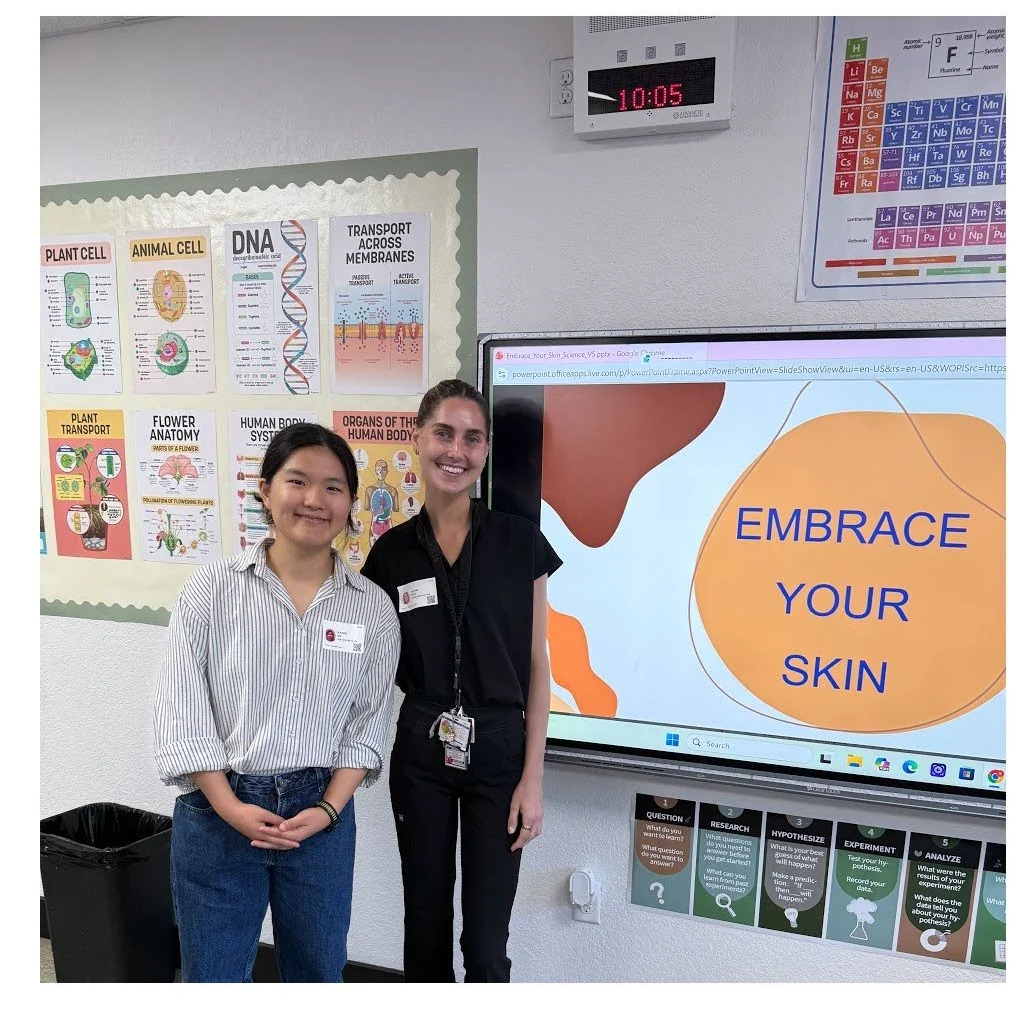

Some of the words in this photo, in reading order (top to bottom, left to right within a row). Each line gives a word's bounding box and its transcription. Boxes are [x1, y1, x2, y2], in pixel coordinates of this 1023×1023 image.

[934, 38, 941, 47] 9
[852, 44, 860, 53] H
[984, 46, 1004, 55] Symbol
[947, 46, 957, 63] F
[850, 67, 858, 76] Li
[619, 84, 683, 111] 10:05
[846, 90, 858, 99] Na
[868, 88, 883, 98] Mg
[891, 109, 901, 117] Sc
[915, 106, 924, 115] Ti
[940, 104, 947, 113] V
[961, 102, 972, 112] Cr
[982, 100, 999, 110] Mn
[867, 111, 879, 119] Ca
[348, 222, 412, 237] TRANSPORT
[232, 229, 274, 254] DNA
[358, 237, 402, 250] ACROSS
[46, 247, 78, 262] PLANT
[81, 246, 106, 261] CELL
[132, 242, 174, 258] ANIMAL
[177, 240, 204, 255] CELL
[346, 250, 415, 265] MEMBRANES
[71, 413, 98, 424] PLANT
[153, 415, 195, 428] FLOWER
[240, 417, 275, 429] HUMAN
[342, 415, 382, 428] ORGANS
[385, 416, 397, 428] OF
[61, 425, 110, 435] TRANSPORT
[150, 429, 200, 441] ANATOMY
[348, 429, 384, 441] HUMAN
[387, 429, 412, 441] BODY
[736, 507, 970, 549] EMBRACE
[776, 582, 909, 622] YOUR
[782, 654, 888, 693] SKIN
[706, 739, 730, 750] Search
[646, 811, 683, 822] QUESTION
[710, 821, 749, 832] RESEARCH
[722, 836, 752, 846] questions
[772, 830, 825, 843] HYPOTHESIZE
[658, 847, 683, 856] question
[844, 840, 896, 854] EXPERIMENT
[730, 851, 749, 859] before
[925, 852, 961, 863] ANALYZE
[726, 858, 751, 866] started?
[789, 860, 816, 869] happen?
[852, 864, 882, 872] pothesis.
[846, 876, 869, 884] Record
[919, 881, 961, 891] experiment?
[914, 894, 931, 902] What
[919, 917, 951, 927] pothesis?
